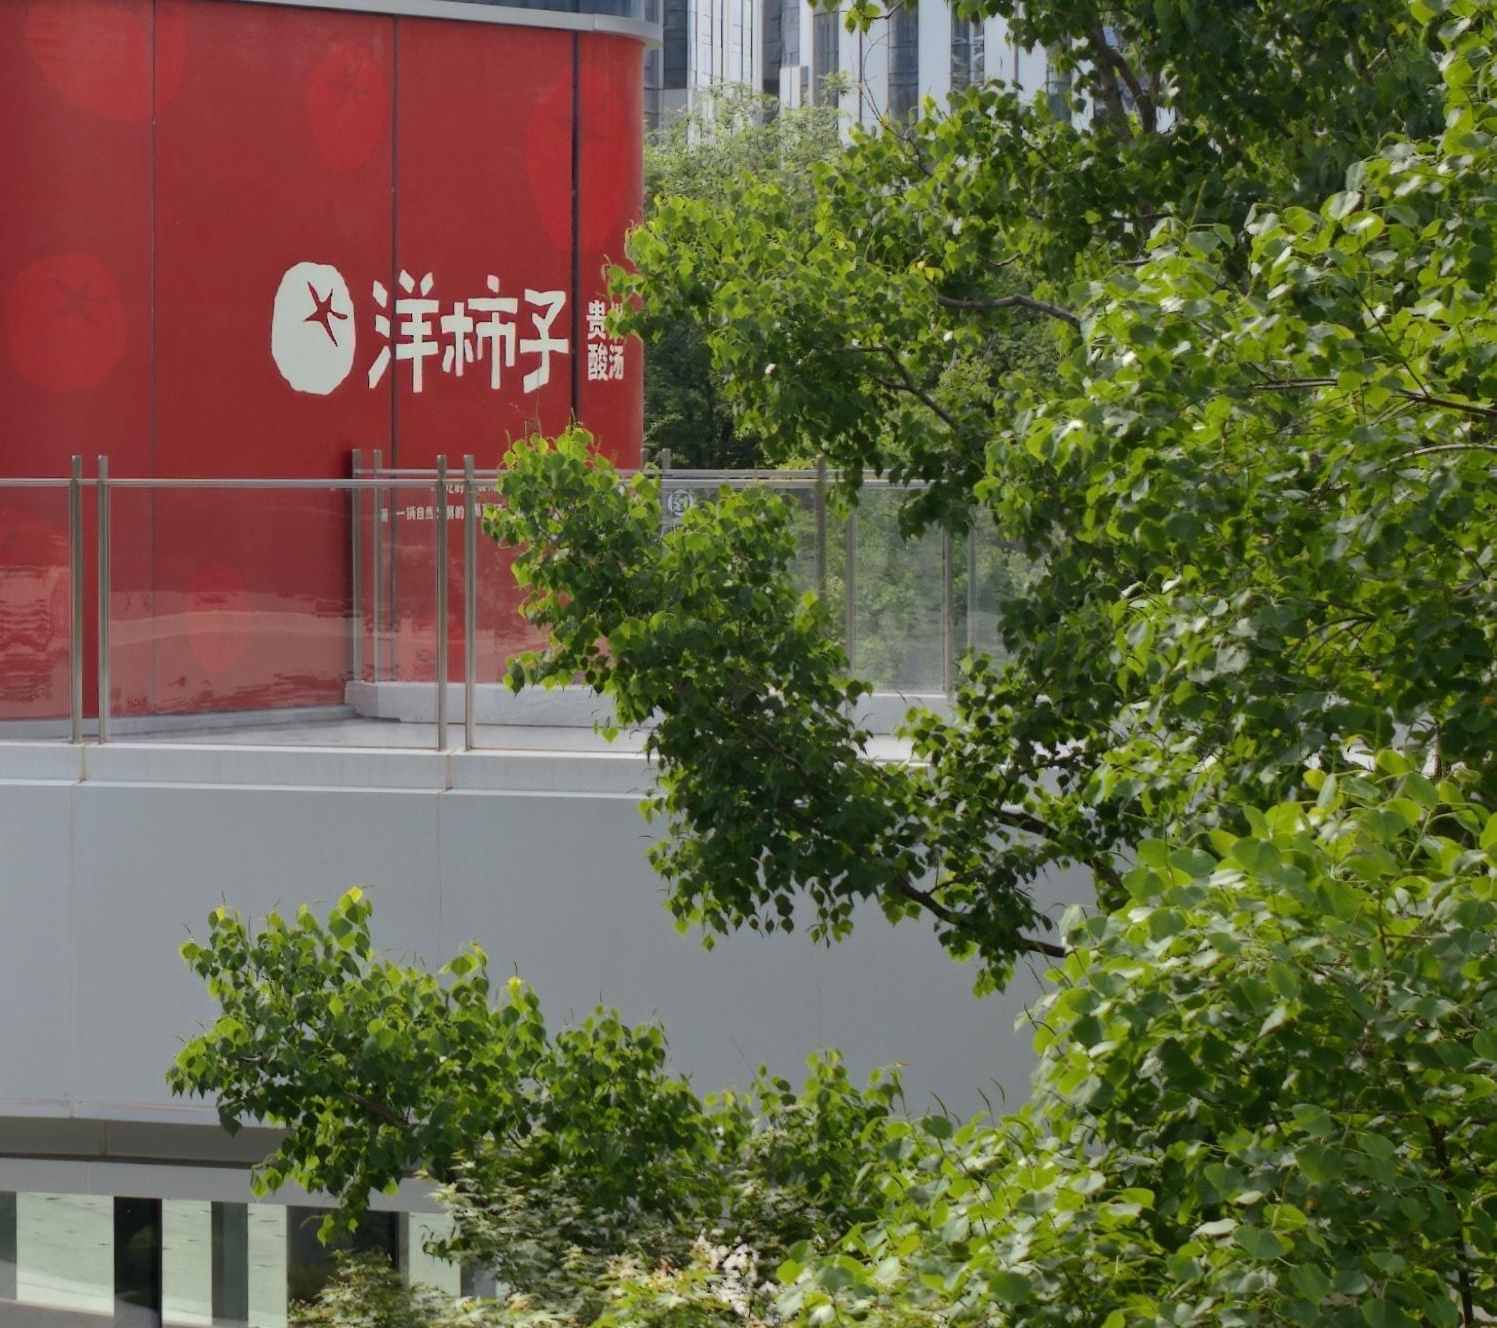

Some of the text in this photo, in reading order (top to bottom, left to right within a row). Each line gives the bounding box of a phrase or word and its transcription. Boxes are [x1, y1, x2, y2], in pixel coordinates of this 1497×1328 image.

[367, 268, 570, 394] 洋柿子
[587, 341, 625, 381] 酸汤
